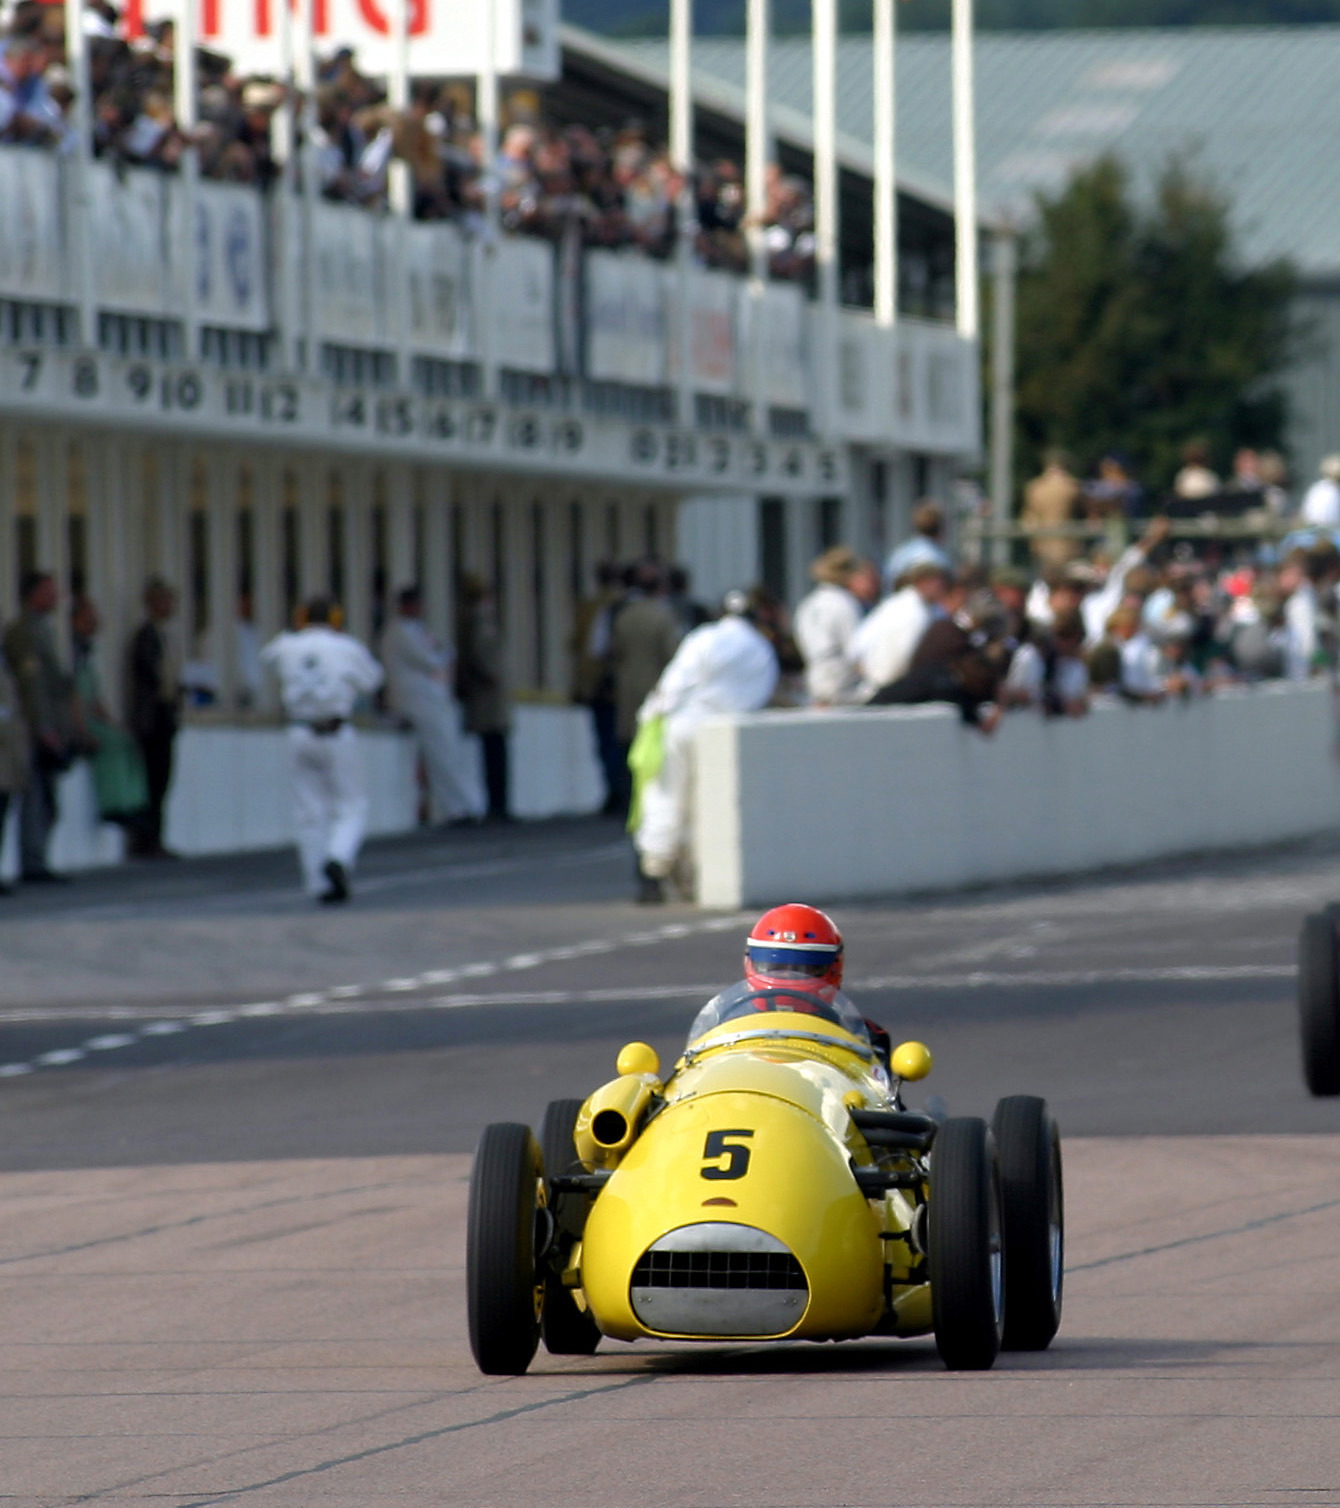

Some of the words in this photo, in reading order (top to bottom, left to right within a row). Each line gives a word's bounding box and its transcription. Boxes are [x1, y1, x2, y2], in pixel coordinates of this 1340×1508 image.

[18, 351, 41, 391] 7
[73, 355, 99, 398] 8
[127, 362, 152, 403] 9
[161, 369, 203, 411] 10
[701, 1128, 755, 1180] 5
